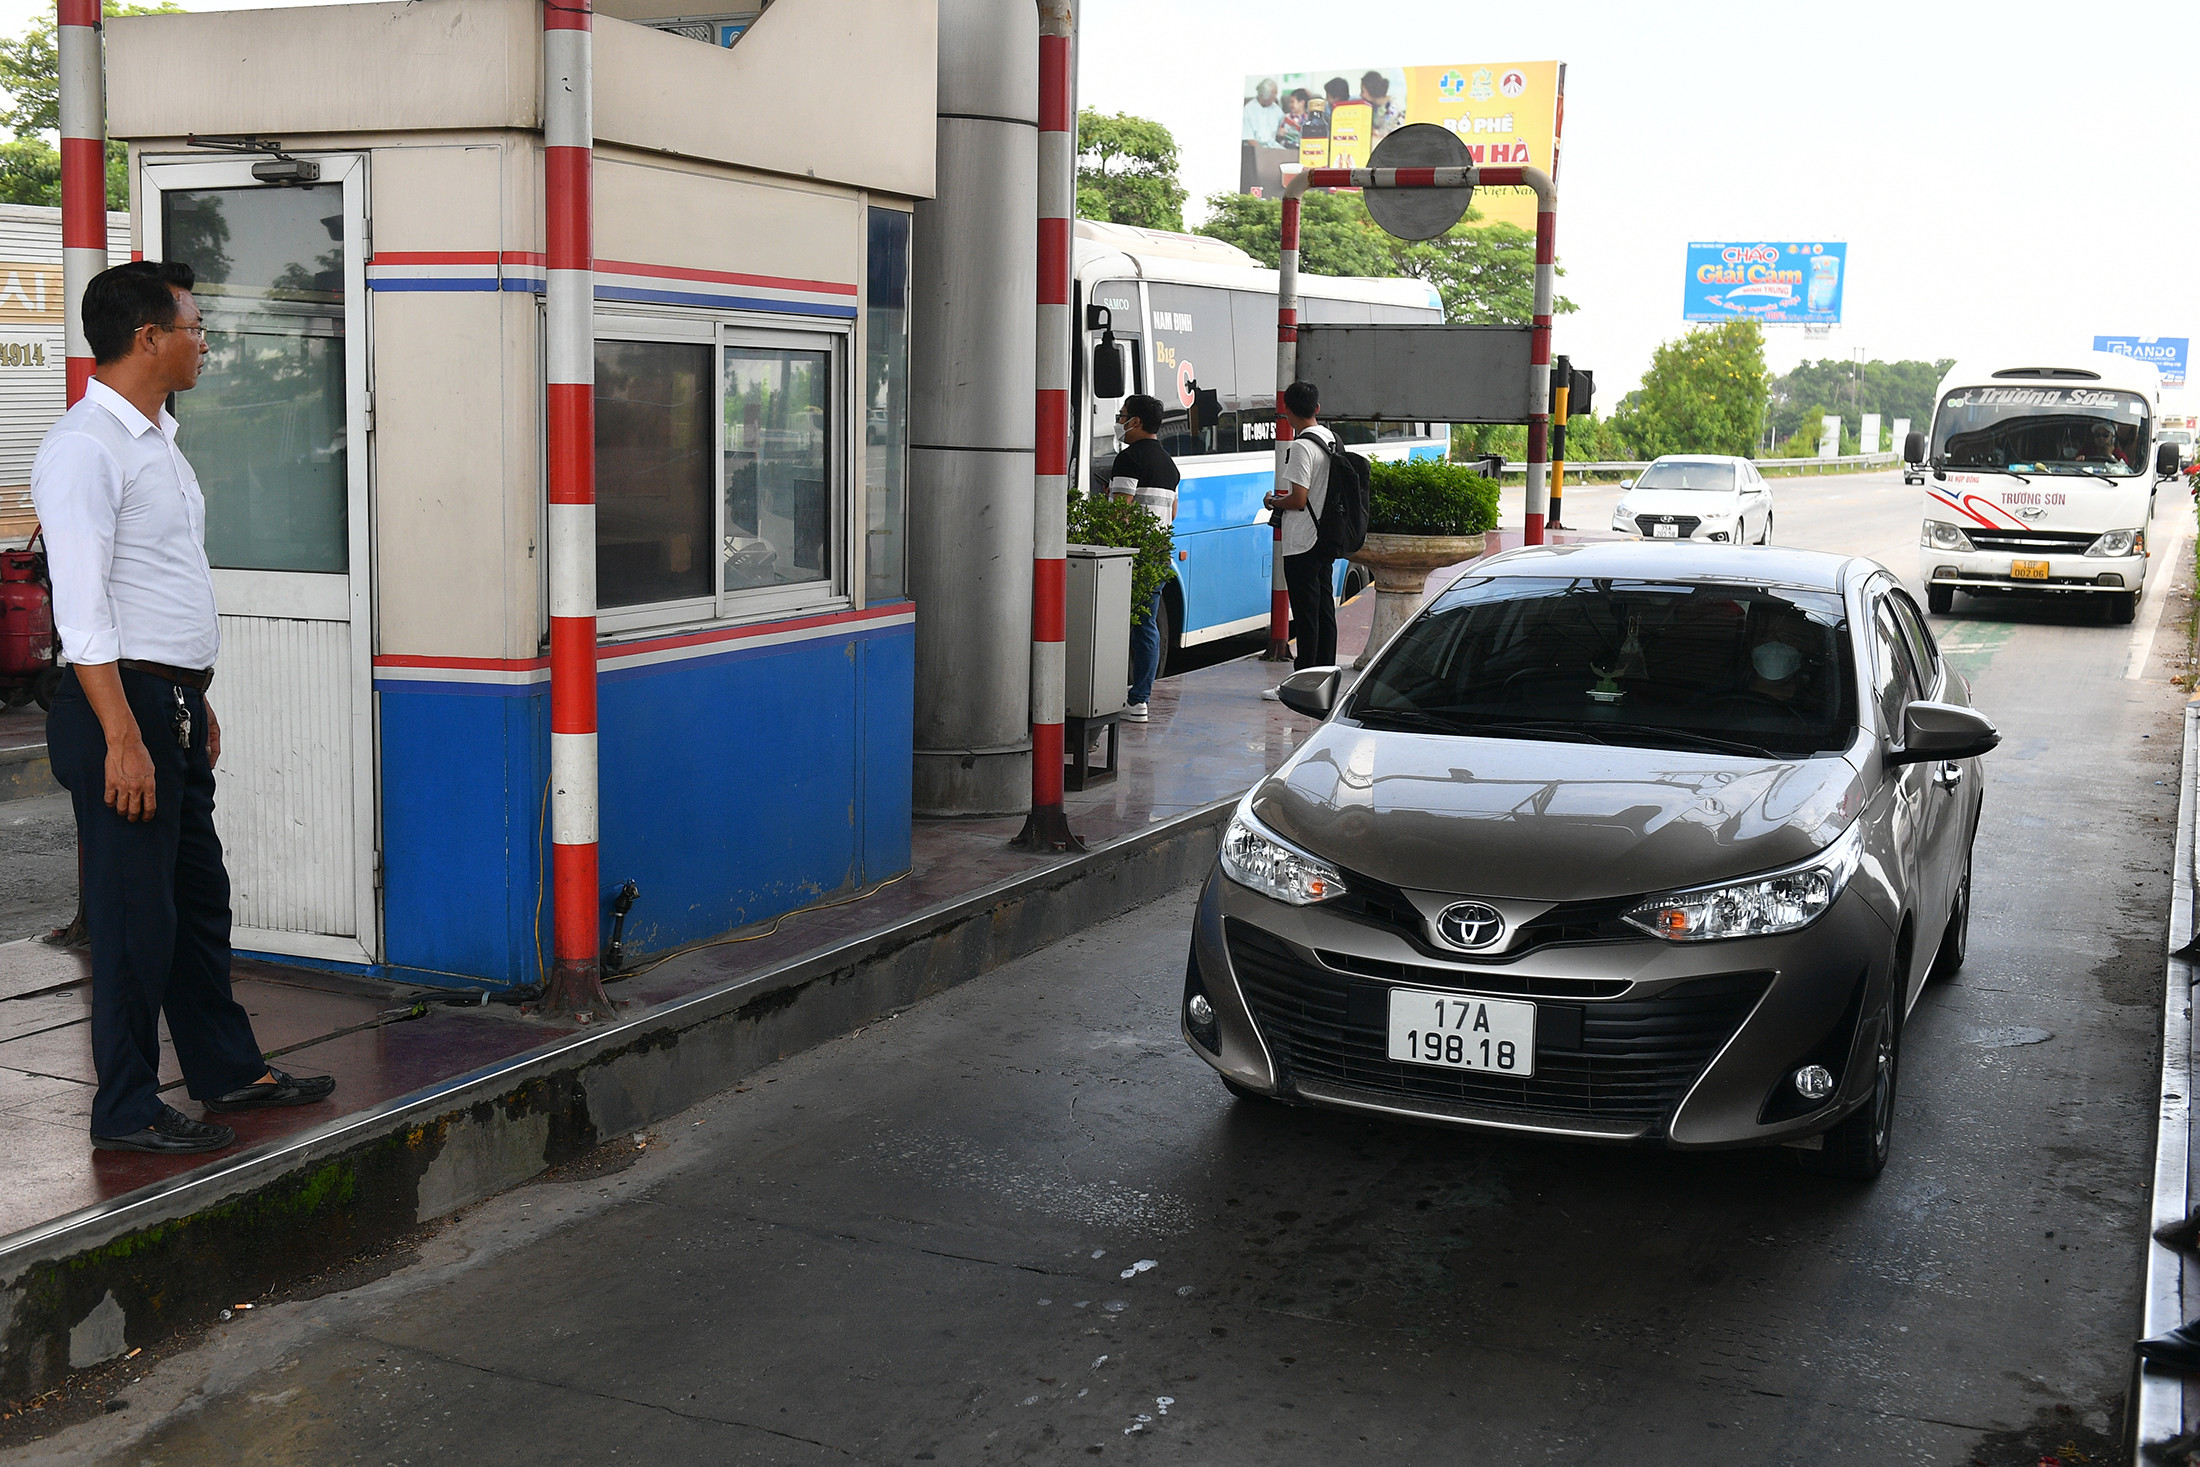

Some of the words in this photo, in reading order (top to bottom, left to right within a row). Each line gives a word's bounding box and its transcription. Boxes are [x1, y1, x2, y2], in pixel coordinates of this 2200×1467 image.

[1490, 137, 1530, 163] HÀ
[1697, 263, 1745, 284] Giải
[1747, 263, 1803, 284] Cảm
[1764, 286, 1790, 296] TRUNG
[1103, 298, 1130, 310] SAMCO
[1153, 310, 1173, 330] NAM
[1173, 312, 1193, 334] ĐỊNH
[0, 342, 45, 367] 4914
[2112, 344, 2177, 358] GRANDO
[1156, 341, 1176, 369] Big
[1177, 359, 1195, 409] C
[2044, 492, 2066, 505] SƠN
[1434, 999, 1490, 1033] 17A
[1407, 1030, 1516, 1070] 198.18
